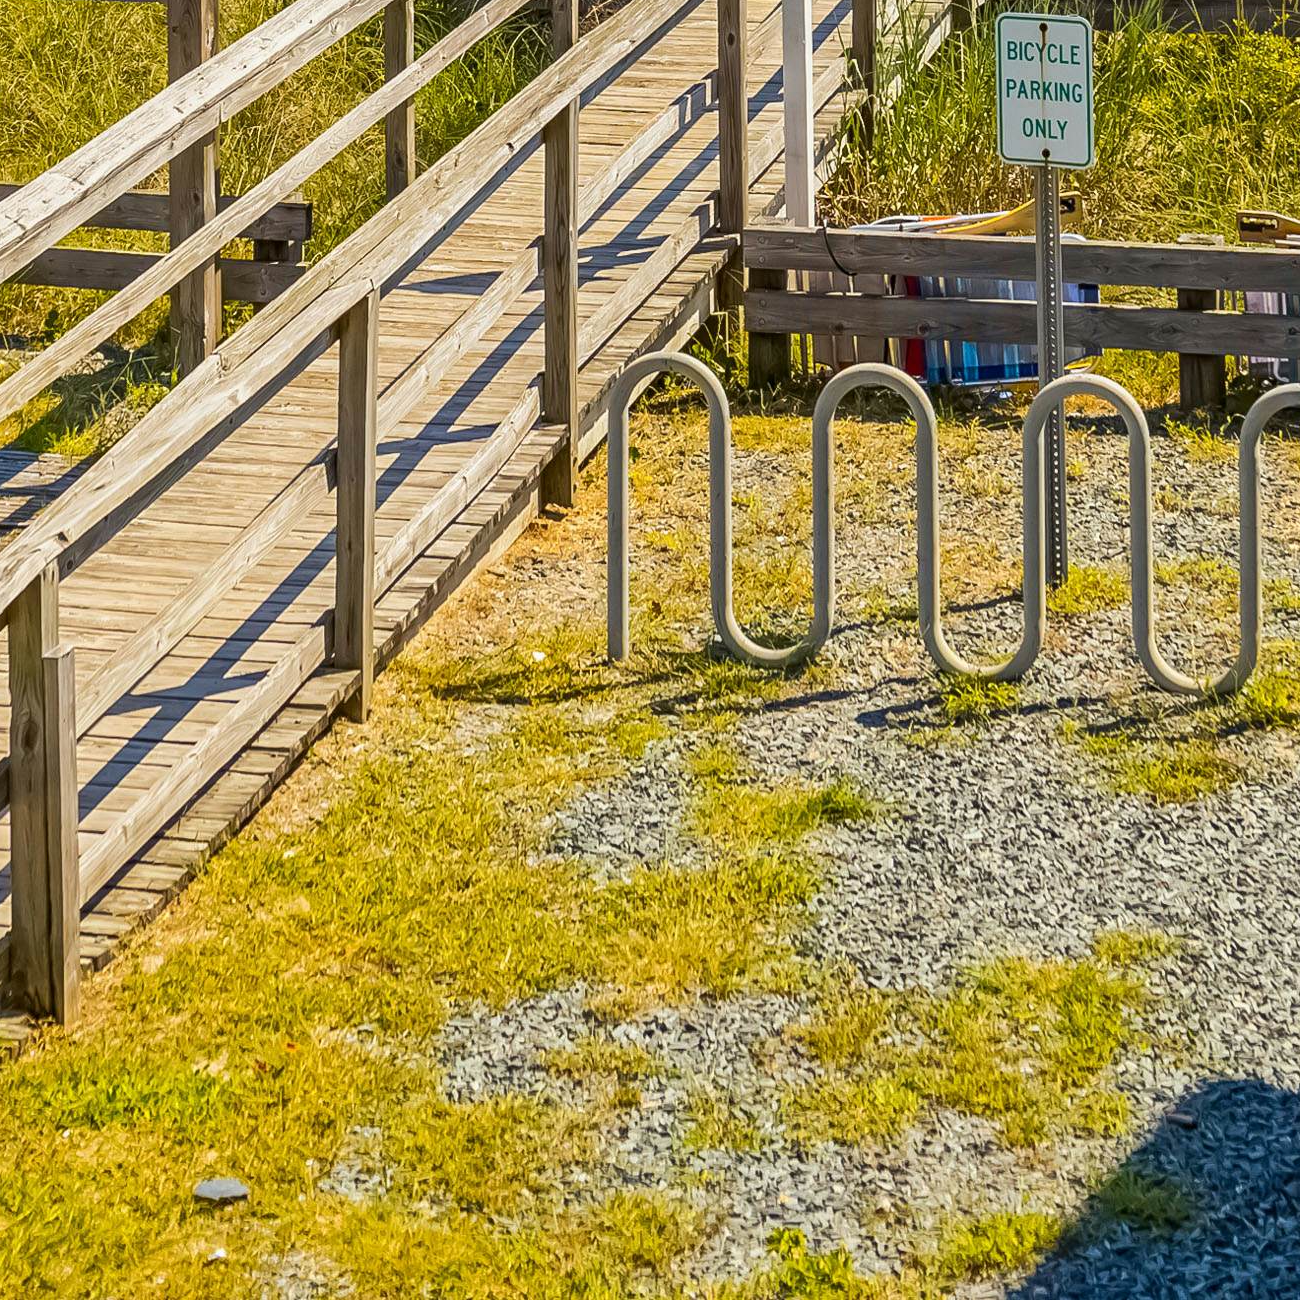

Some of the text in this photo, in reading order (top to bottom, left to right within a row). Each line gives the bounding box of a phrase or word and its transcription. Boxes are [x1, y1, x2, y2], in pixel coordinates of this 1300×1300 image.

[1007, 41, 1080, 65] BICYCLE
[1006, 79, 1082, 103] PARKING
[1022, 118, 1068, 140] ONLY
